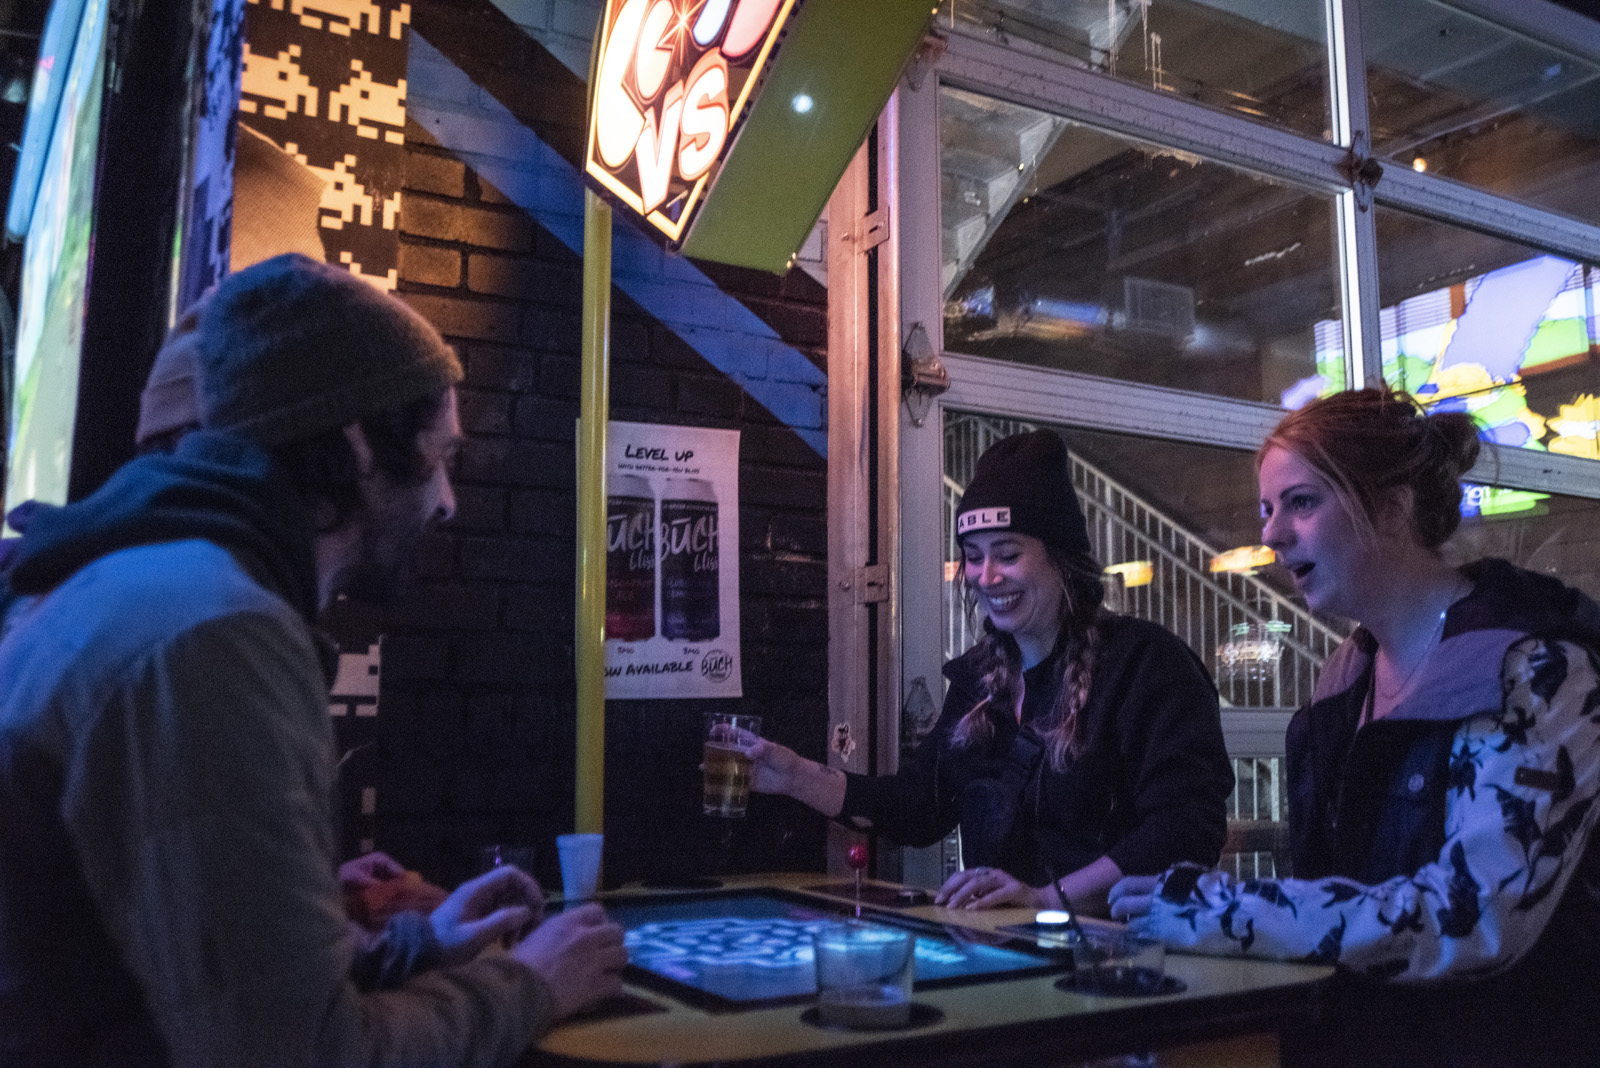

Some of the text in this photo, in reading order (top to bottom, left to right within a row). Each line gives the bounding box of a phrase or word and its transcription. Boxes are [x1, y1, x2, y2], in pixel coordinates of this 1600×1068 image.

[624, 444, 694, 462] LEVEL UP
[625, 661, 694, 676] AVAILABLE
